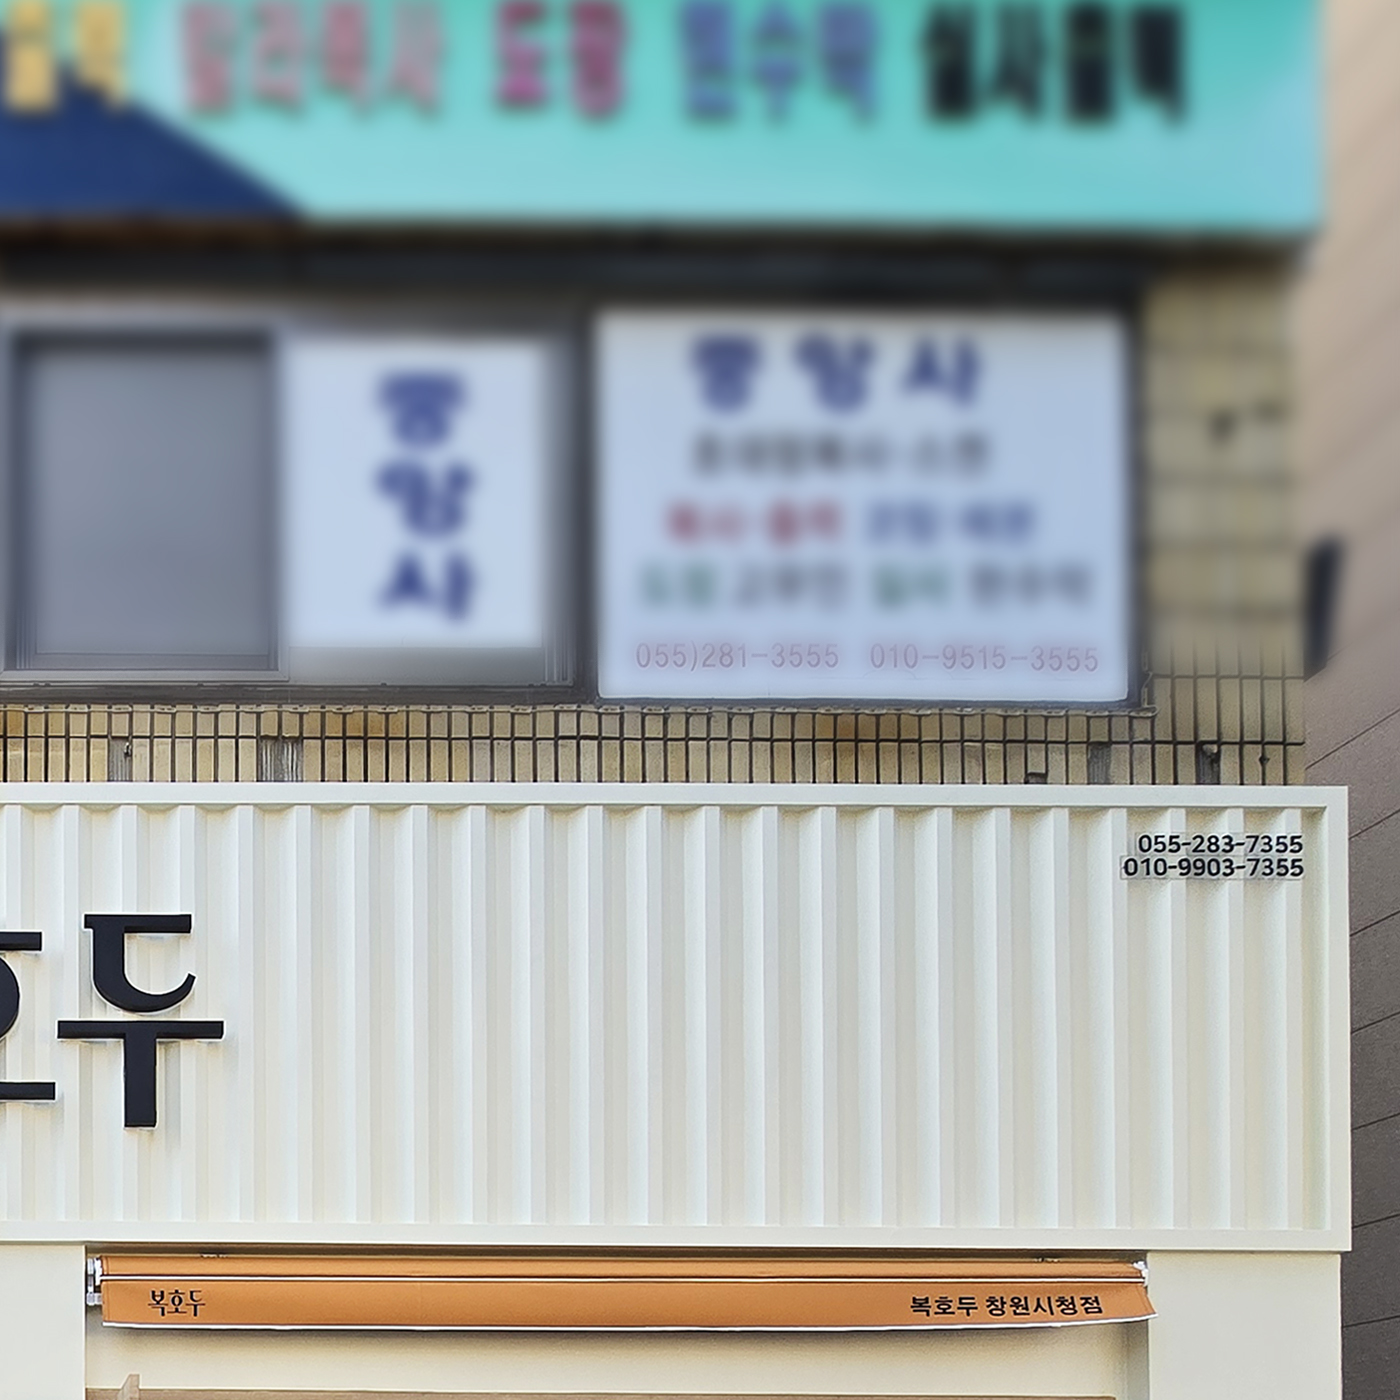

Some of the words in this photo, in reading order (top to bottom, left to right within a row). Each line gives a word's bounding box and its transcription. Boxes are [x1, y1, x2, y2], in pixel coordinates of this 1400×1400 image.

[635, 640, 840, 672] 055)281-3555
[870, 642, 1100, 674] 010-9515-3555
[1137, 834, 1304, 854] 055-283-7355
[1122, 857, 1305, 877] 010-9903-7355
[147, 1289, 207, 1317] 복호두
[910, 1295, 979, 1317] 복호두
[985, 1295, 1104, 1317] 창원시청점
